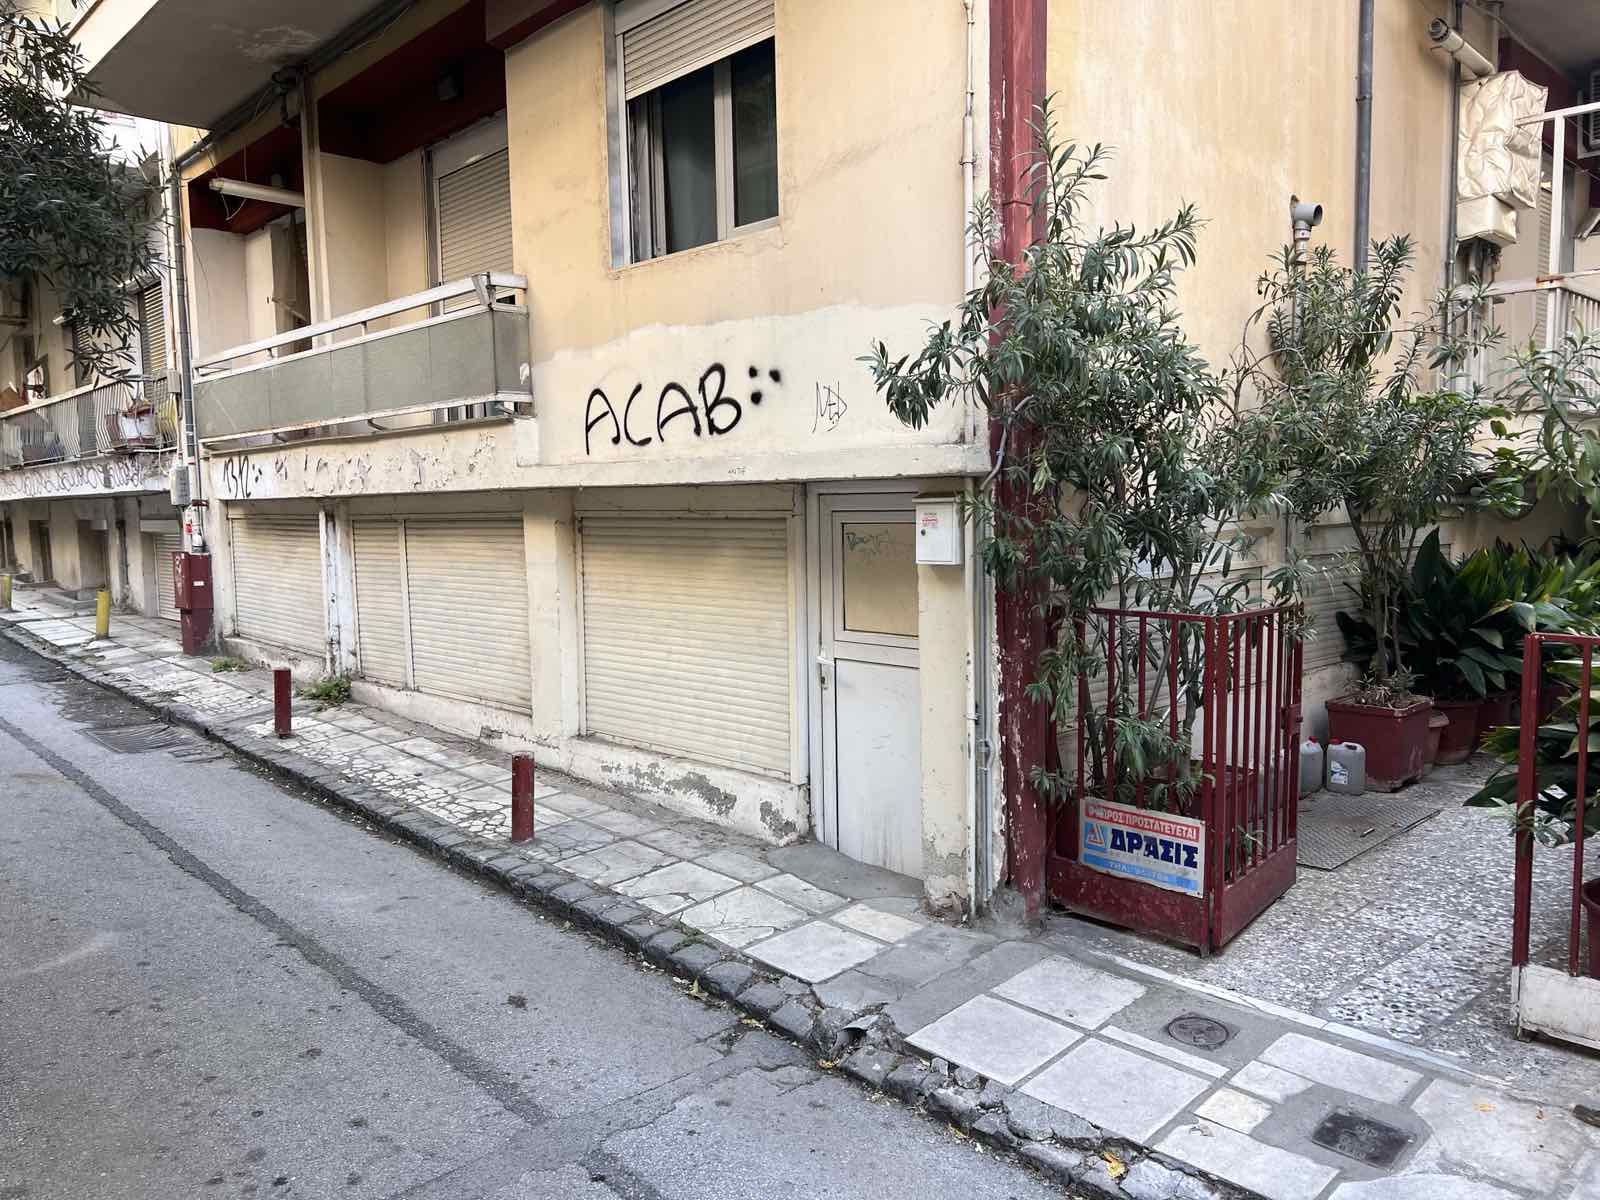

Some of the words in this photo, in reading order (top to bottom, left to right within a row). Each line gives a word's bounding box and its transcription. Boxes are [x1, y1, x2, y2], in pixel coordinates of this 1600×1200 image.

[585, 363, 742, 455] ACAB
[1125, 812, 1197, 839] ΠΡΟΣΤΑΤΕΥΕΤΑΙ
[1110, 829, 1199, 868] ΔΡΑΣΙΣ
